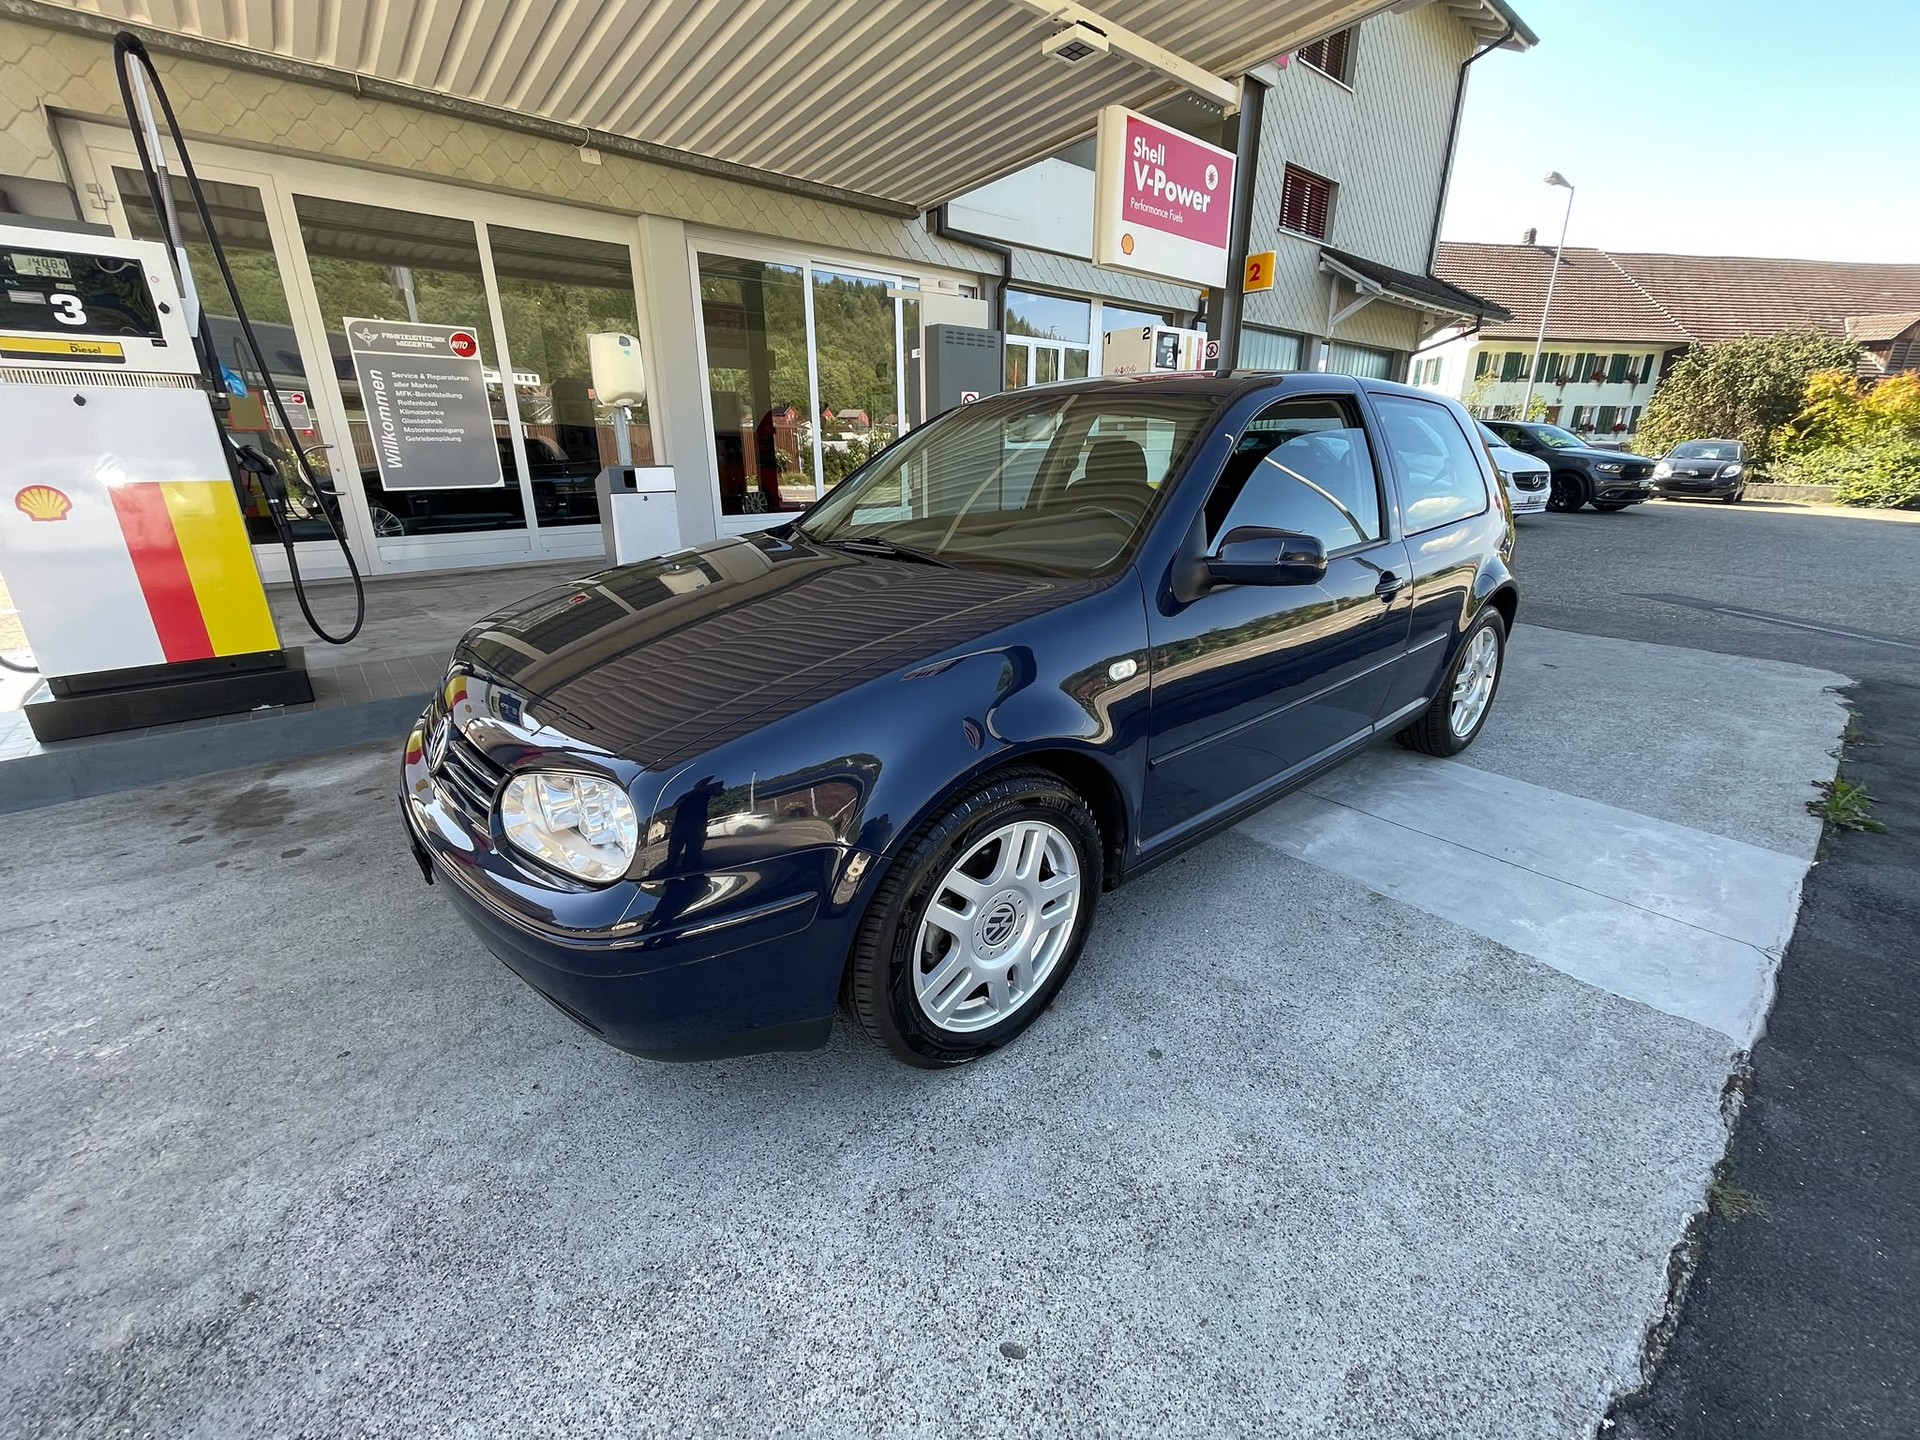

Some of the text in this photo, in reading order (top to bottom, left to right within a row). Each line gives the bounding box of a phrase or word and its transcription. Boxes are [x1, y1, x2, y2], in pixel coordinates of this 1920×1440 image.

[1133, 136, 1165, 166] Shell
[1133, 160, 1211, 213] V-Power
[1130, 197, 1184, 224] Performance Fuels
[1249, 263, 1261, 282] 2
[50, 293, 87, 325] 3
[1104, 332, 1111, 345] 1
[1142, 326, 1151, 340] 2
[69, 345, 102, 354] Diesel
[1166, 352, 1174, 366] 2
[391, 371, 419, 379] Service
[427, 373, 470, 381] Reparaturen
[395, 390, 463, 400] MFK-Bereitstellung
[397, 399, 438, 407] Reifenhotel
[369, 368, 403, 469] Willkommen
[399, 408, 445, 416] Klimaservice
[403, 426, 465, 434] Motorenreinigung
[405, 435, 462, 443] Getriebespülung
[1039, 795, 1069, 812] SPIRIT
